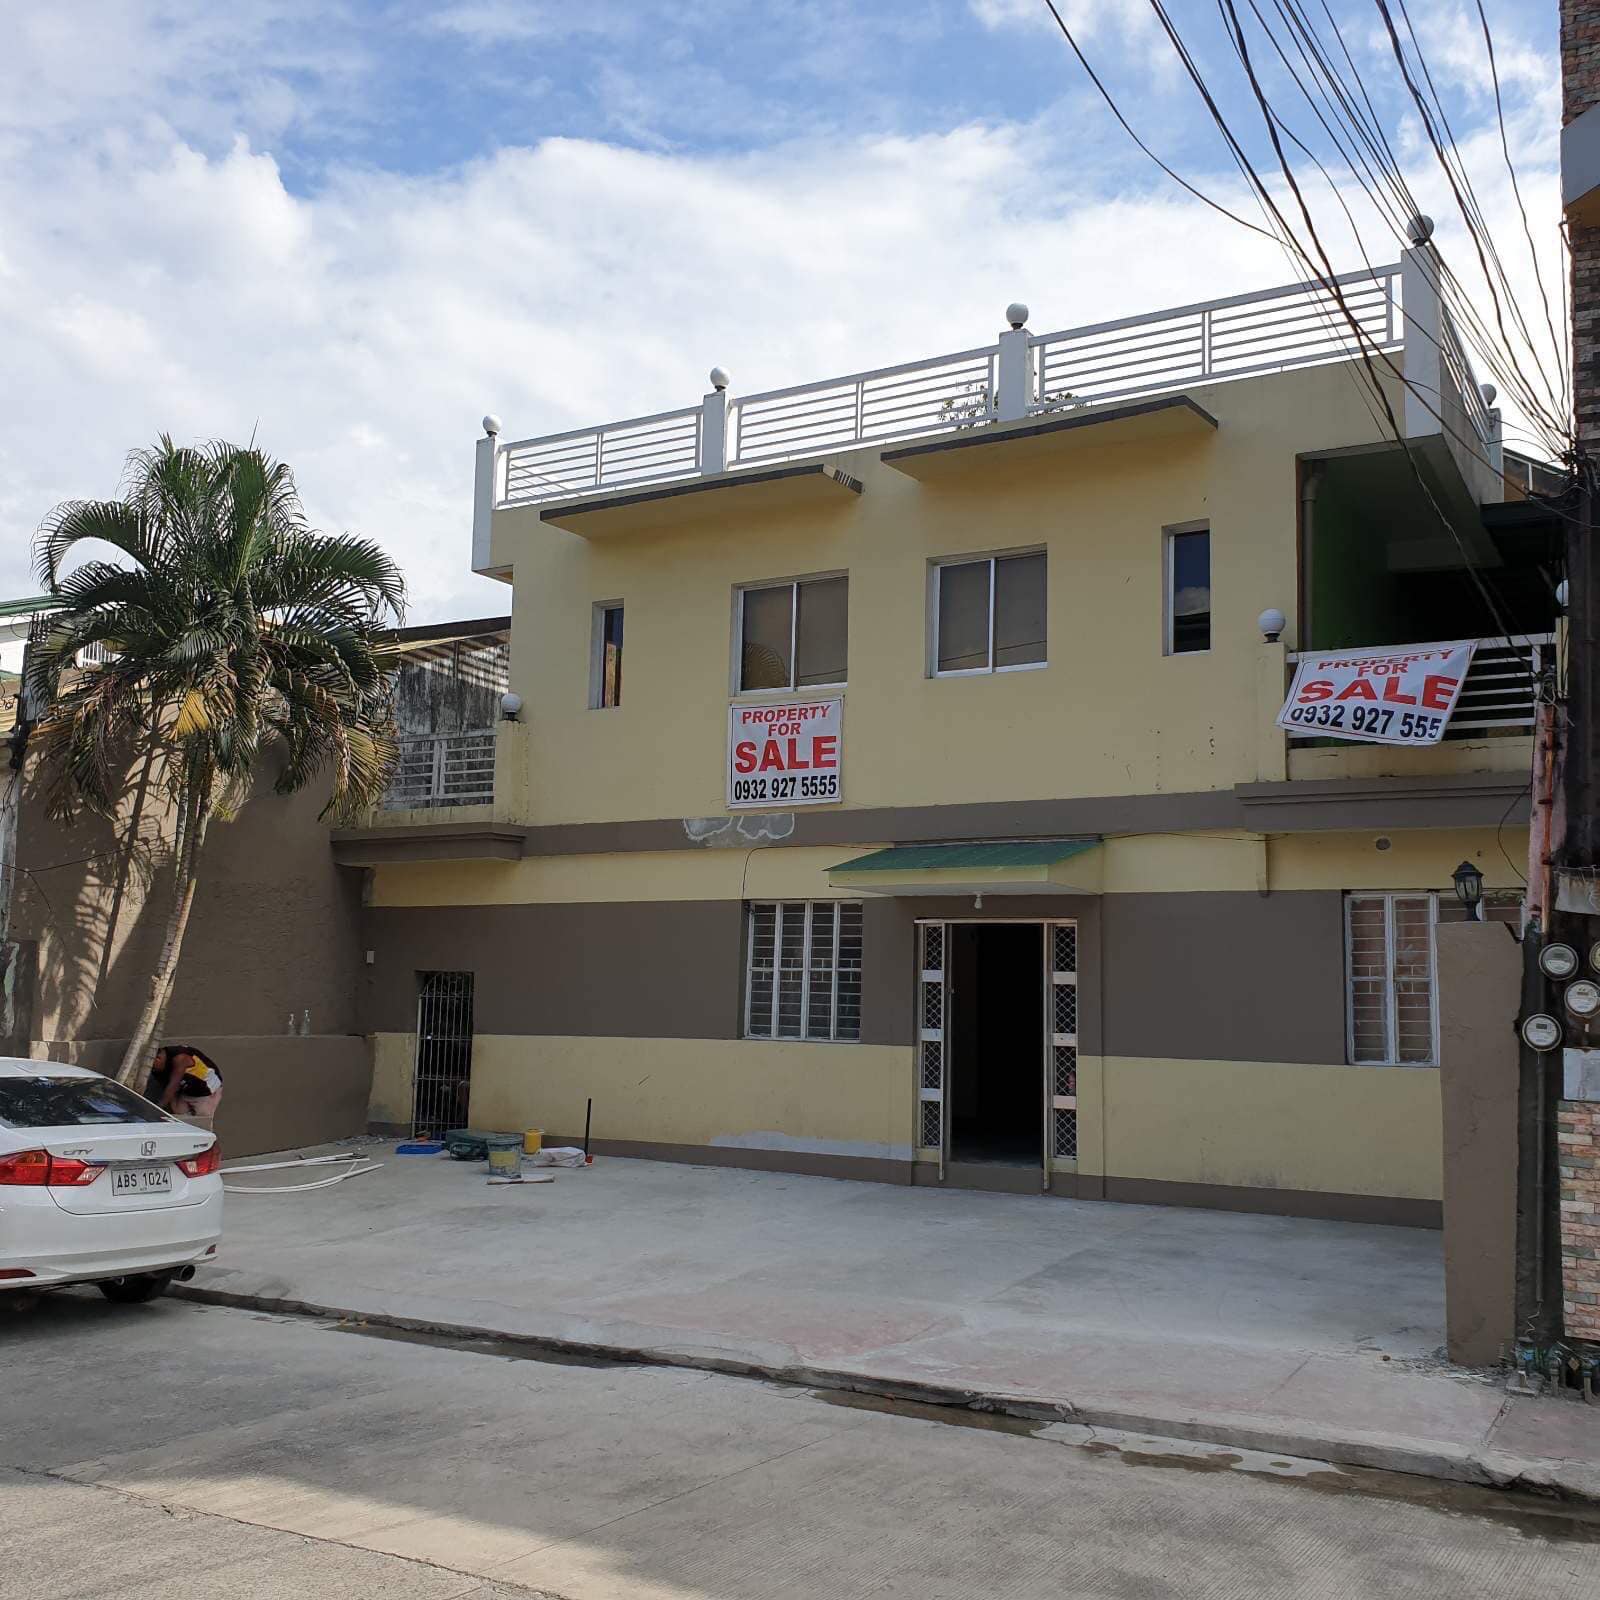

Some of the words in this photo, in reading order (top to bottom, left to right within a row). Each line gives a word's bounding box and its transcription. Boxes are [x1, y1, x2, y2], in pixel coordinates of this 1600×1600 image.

[1318, 650, 1453, 670] PROPERTY
[1358, 663, 1408, 677] FOR
[1297, 675, 1458, 710] SALE
[742, 705, 831, 724] PROPERTY
[1291, 705, 1345, 727] 0932
[1352, 706, 1395, 735] 927
[768, 723, 801, 737] FOR
[735, 736, 837, 773] SALE
[735, 779, 767, 800] 0932
[771, 777, 797, 798] 927
[801, 775, 837, 796] 5555
[117, 1173, 138, 1188] ABS
[142, 1171, 168, 1187] 1024
